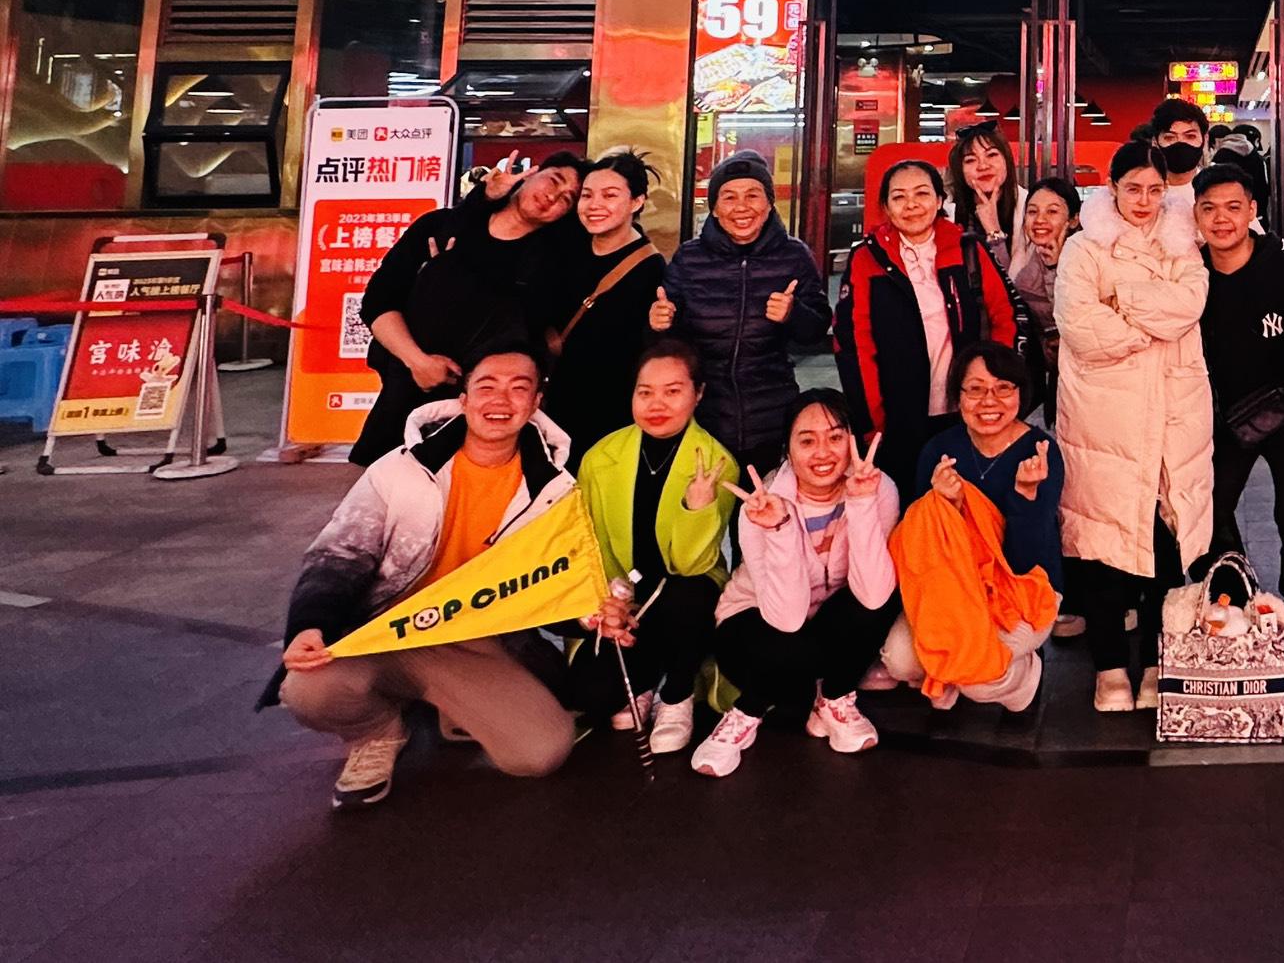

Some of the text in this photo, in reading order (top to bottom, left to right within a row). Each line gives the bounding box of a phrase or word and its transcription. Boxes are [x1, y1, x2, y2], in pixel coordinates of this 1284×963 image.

[390, 128, 432, 140] 大众点评
[315, 156, 441, 183] 点评热门榜
[329, 226, 409, 249] 上榜餐
[1183, 680, 1267, 695] CHRISTIAN DIOR
